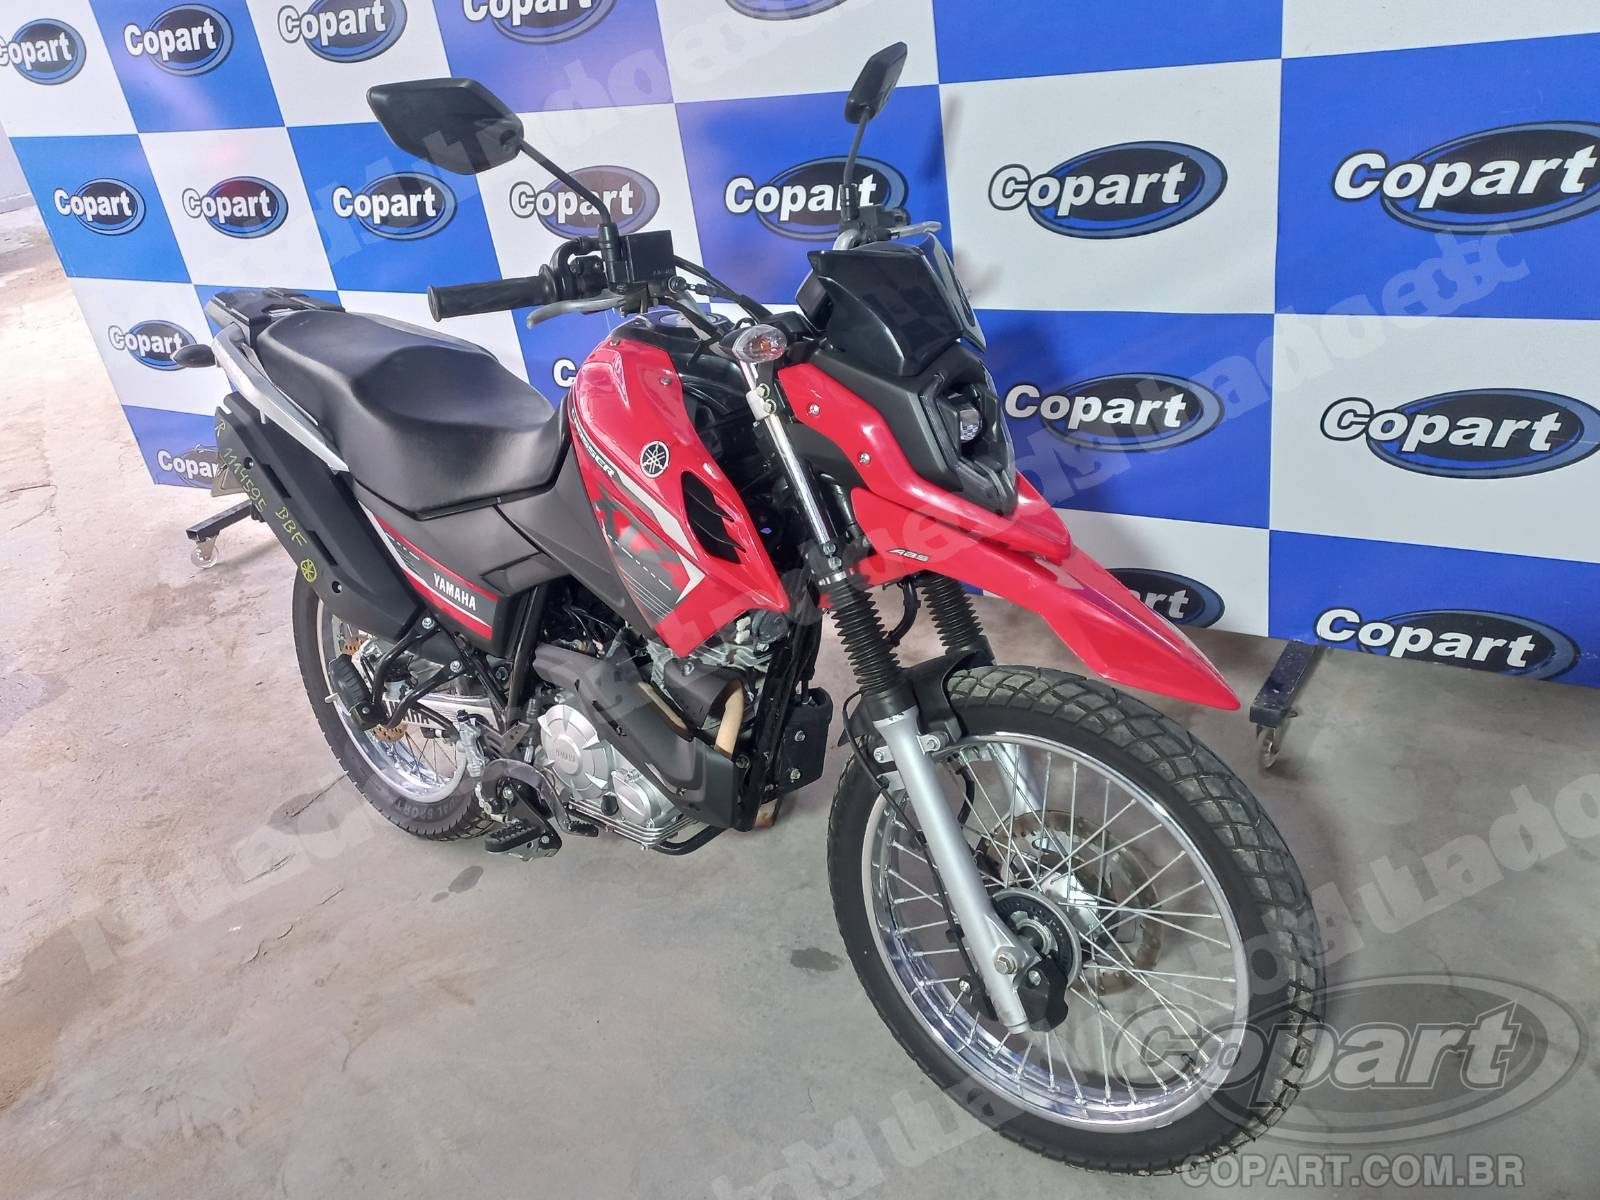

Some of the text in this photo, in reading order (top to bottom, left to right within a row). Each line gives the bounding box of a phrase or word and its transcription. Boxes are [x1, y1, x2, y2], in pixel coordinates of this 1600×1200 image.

[123, 17, 217, 62] Copart
[278, 1, 387, 47] Copart
[991, 162, 1187, 217] Copart
[1333, 144, 1598, 209] Copart
[53, 188, 133, 222] Copart
[182, 188, 273, 224] Copart
[332, 182, 437, 225] Copart
[109, 326, 184, 355] Copart
[1004, 384, 1187, 430] Copart
[1322, 398, 1564, 453] Copart
[157, 449, 216, 479] Copar
[887, 548, 931, 563] ABS
[433, 572, 477, 612] YAMAHA
[1316, 608, 1536, 668] Copart
